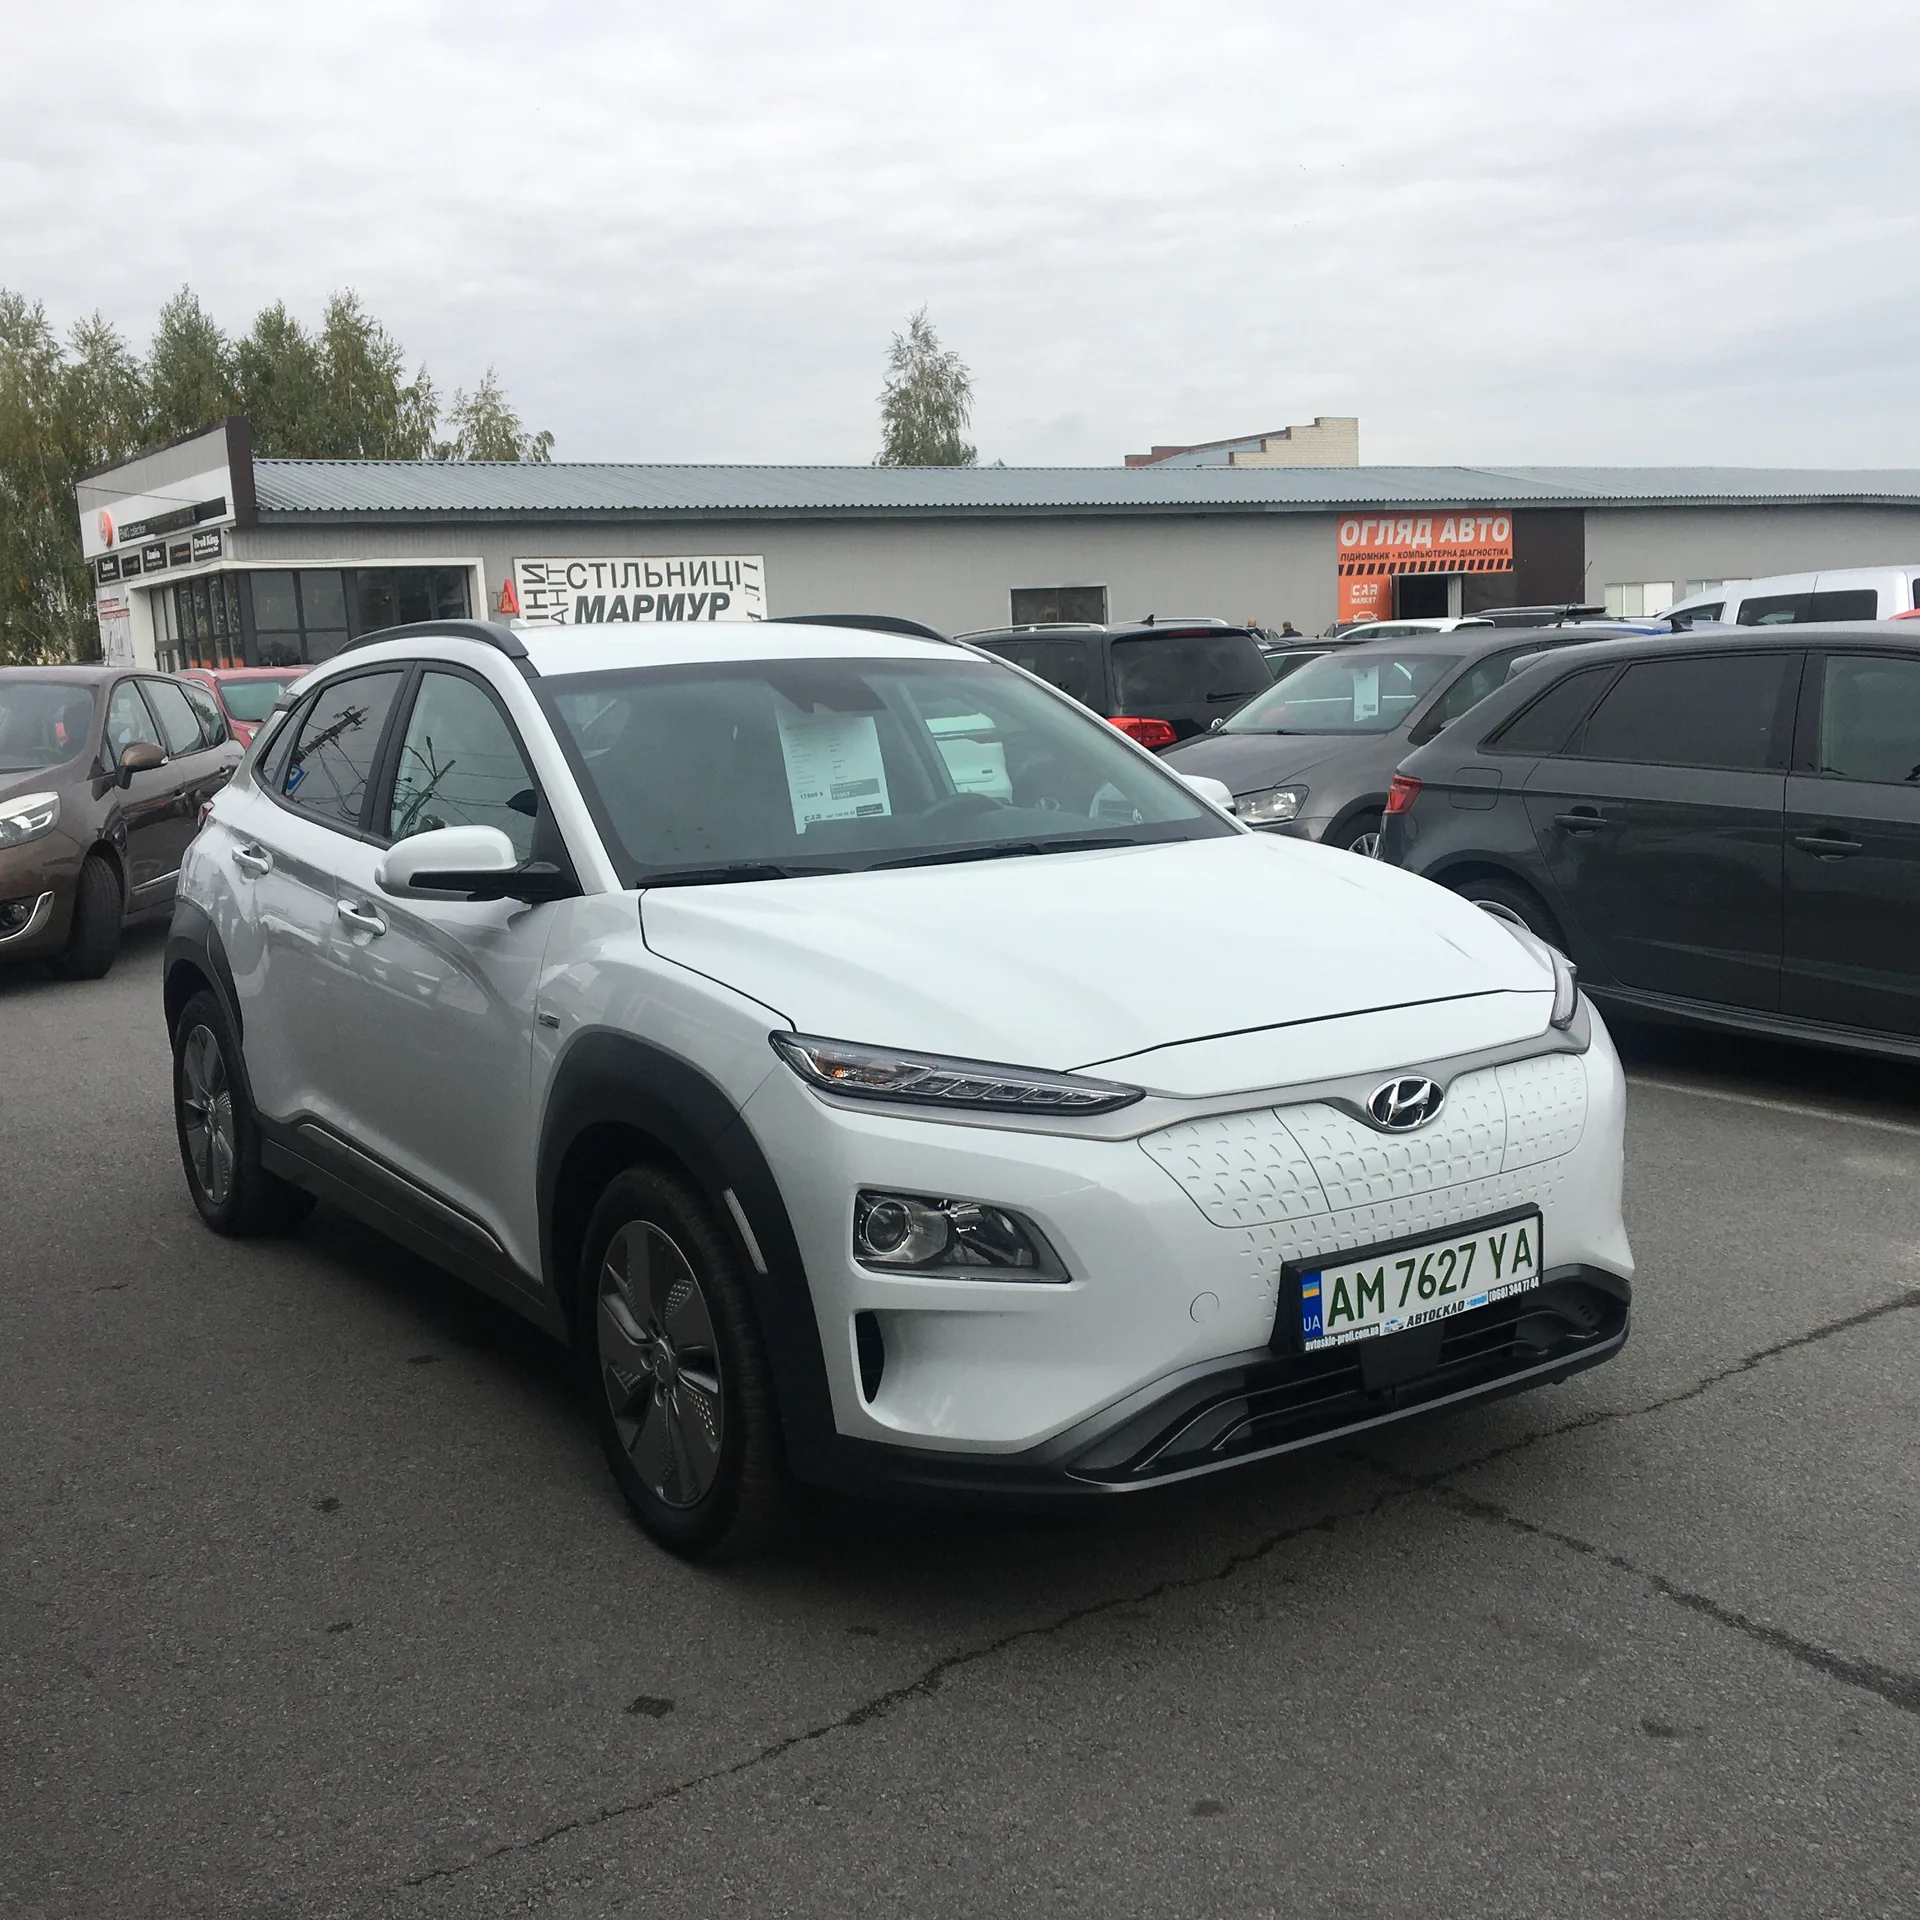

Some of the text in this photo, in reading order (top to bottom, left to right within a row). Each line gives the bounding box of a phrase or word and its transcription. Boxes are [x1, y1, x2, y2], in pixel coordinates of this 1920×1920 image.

[1340, 517, 1510, 549] ОГЛЯД АВТО
[1340, 551, 1390, 561] ПІДЙОМНИК
[566, 560, 742, 591] СТІЛЬНИЦІ
[1352, 583, 1378, 596] CAR
[522, 564, 549, 619] ІНИ
[546, 563, 569, 624] АНІТ
[575, 592, 730, 624] МАРМУР
[1327, 1227, 1533, 1327] AM 7627 YA
[1489, 1286, 1508, 1302] (068)
[1509, 1282, 1522, 1296] 344
[1530, 1276, 1539, 1288] 44
[1303, 1315, 1321, 1332] UA
